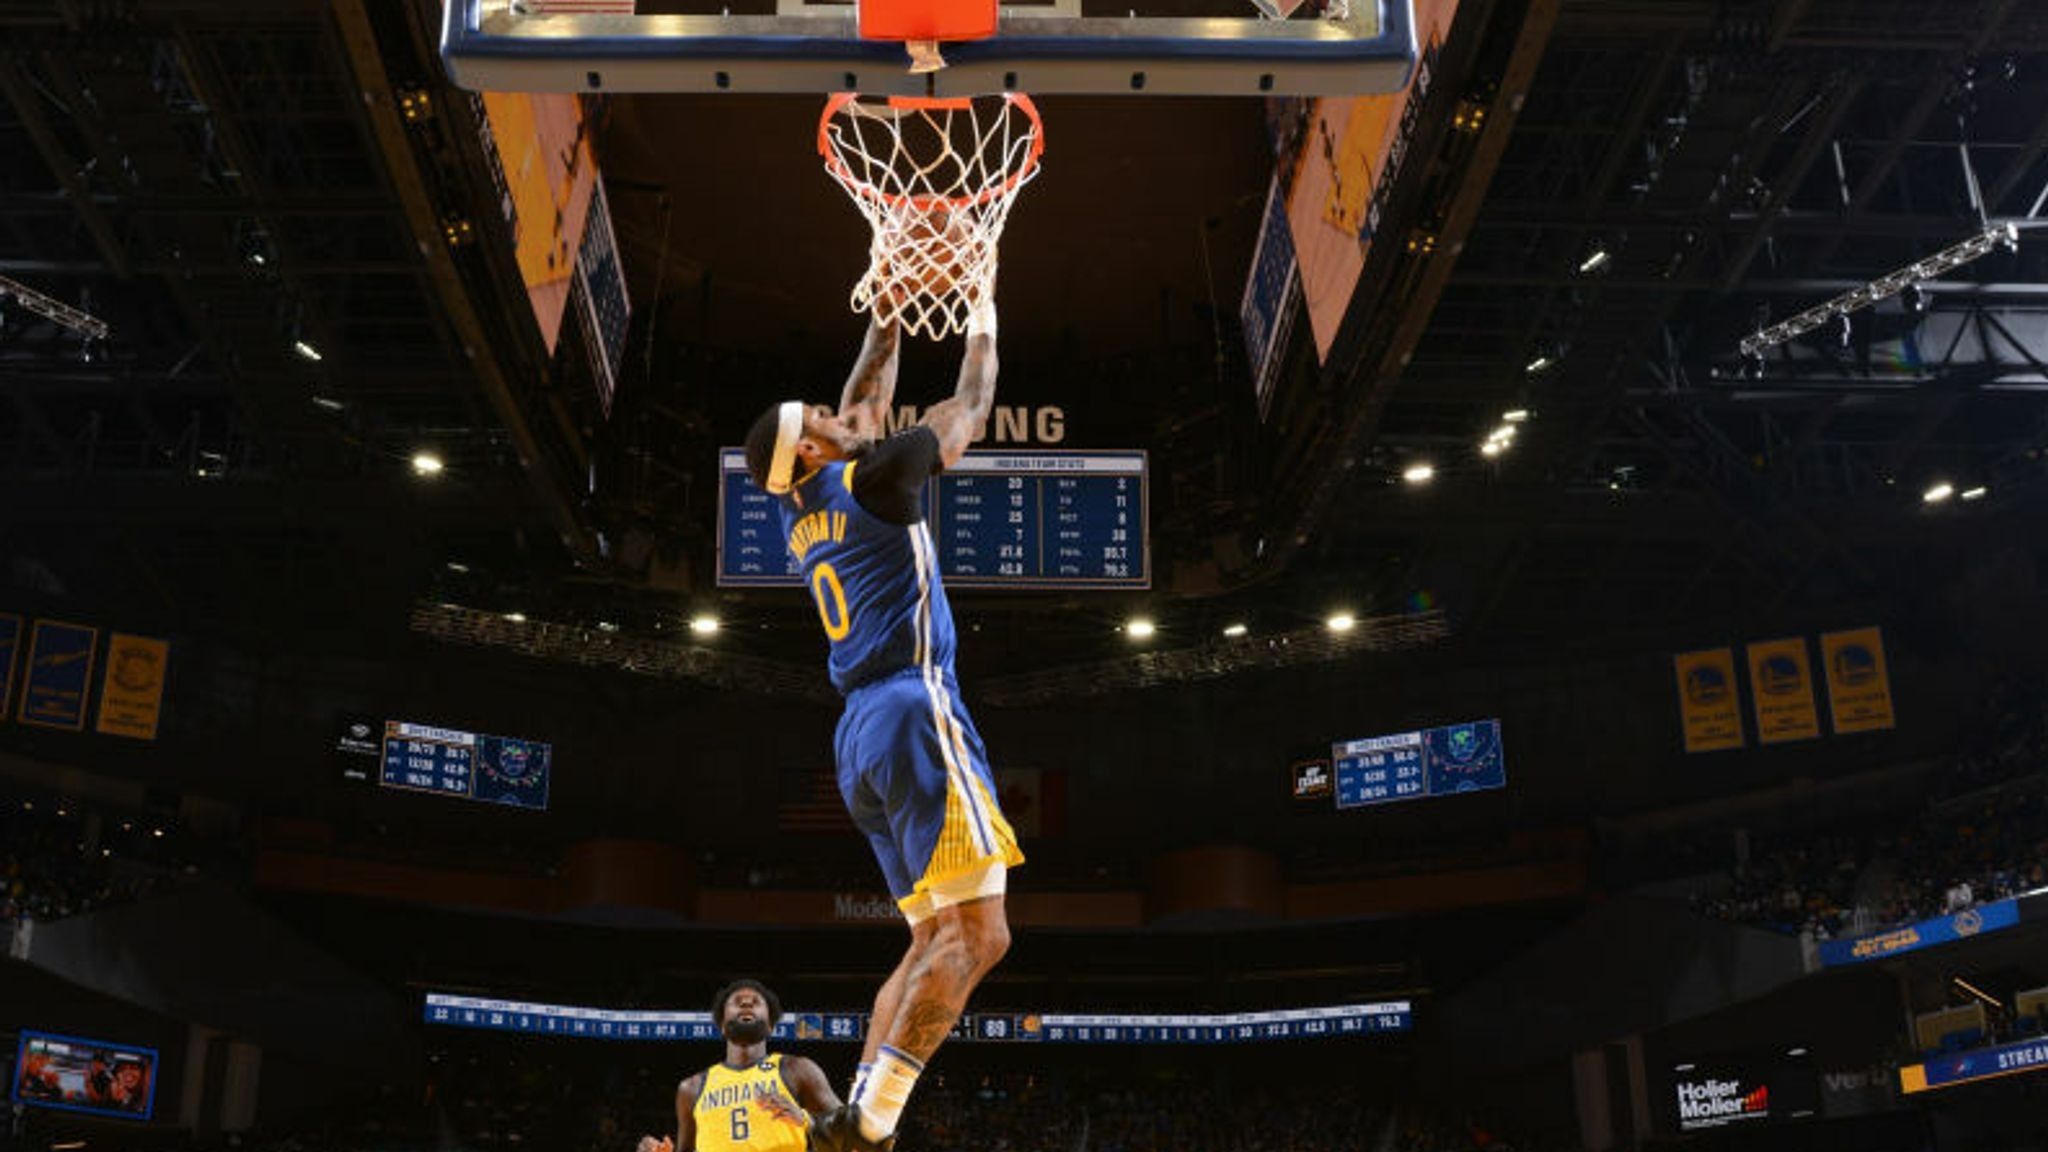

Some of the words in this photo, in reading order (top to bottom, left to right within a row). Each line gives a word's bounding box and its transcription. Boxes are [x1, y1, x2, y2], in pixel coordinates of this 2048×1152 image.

[1115, 494, 1127, 507] 11
[812, 562, 850, 641] 0
[830, 1018, 852, 1036] 92
[701, 1080, 778, 1112] INDIANA
[731, 1107, 748, 1142] 6
